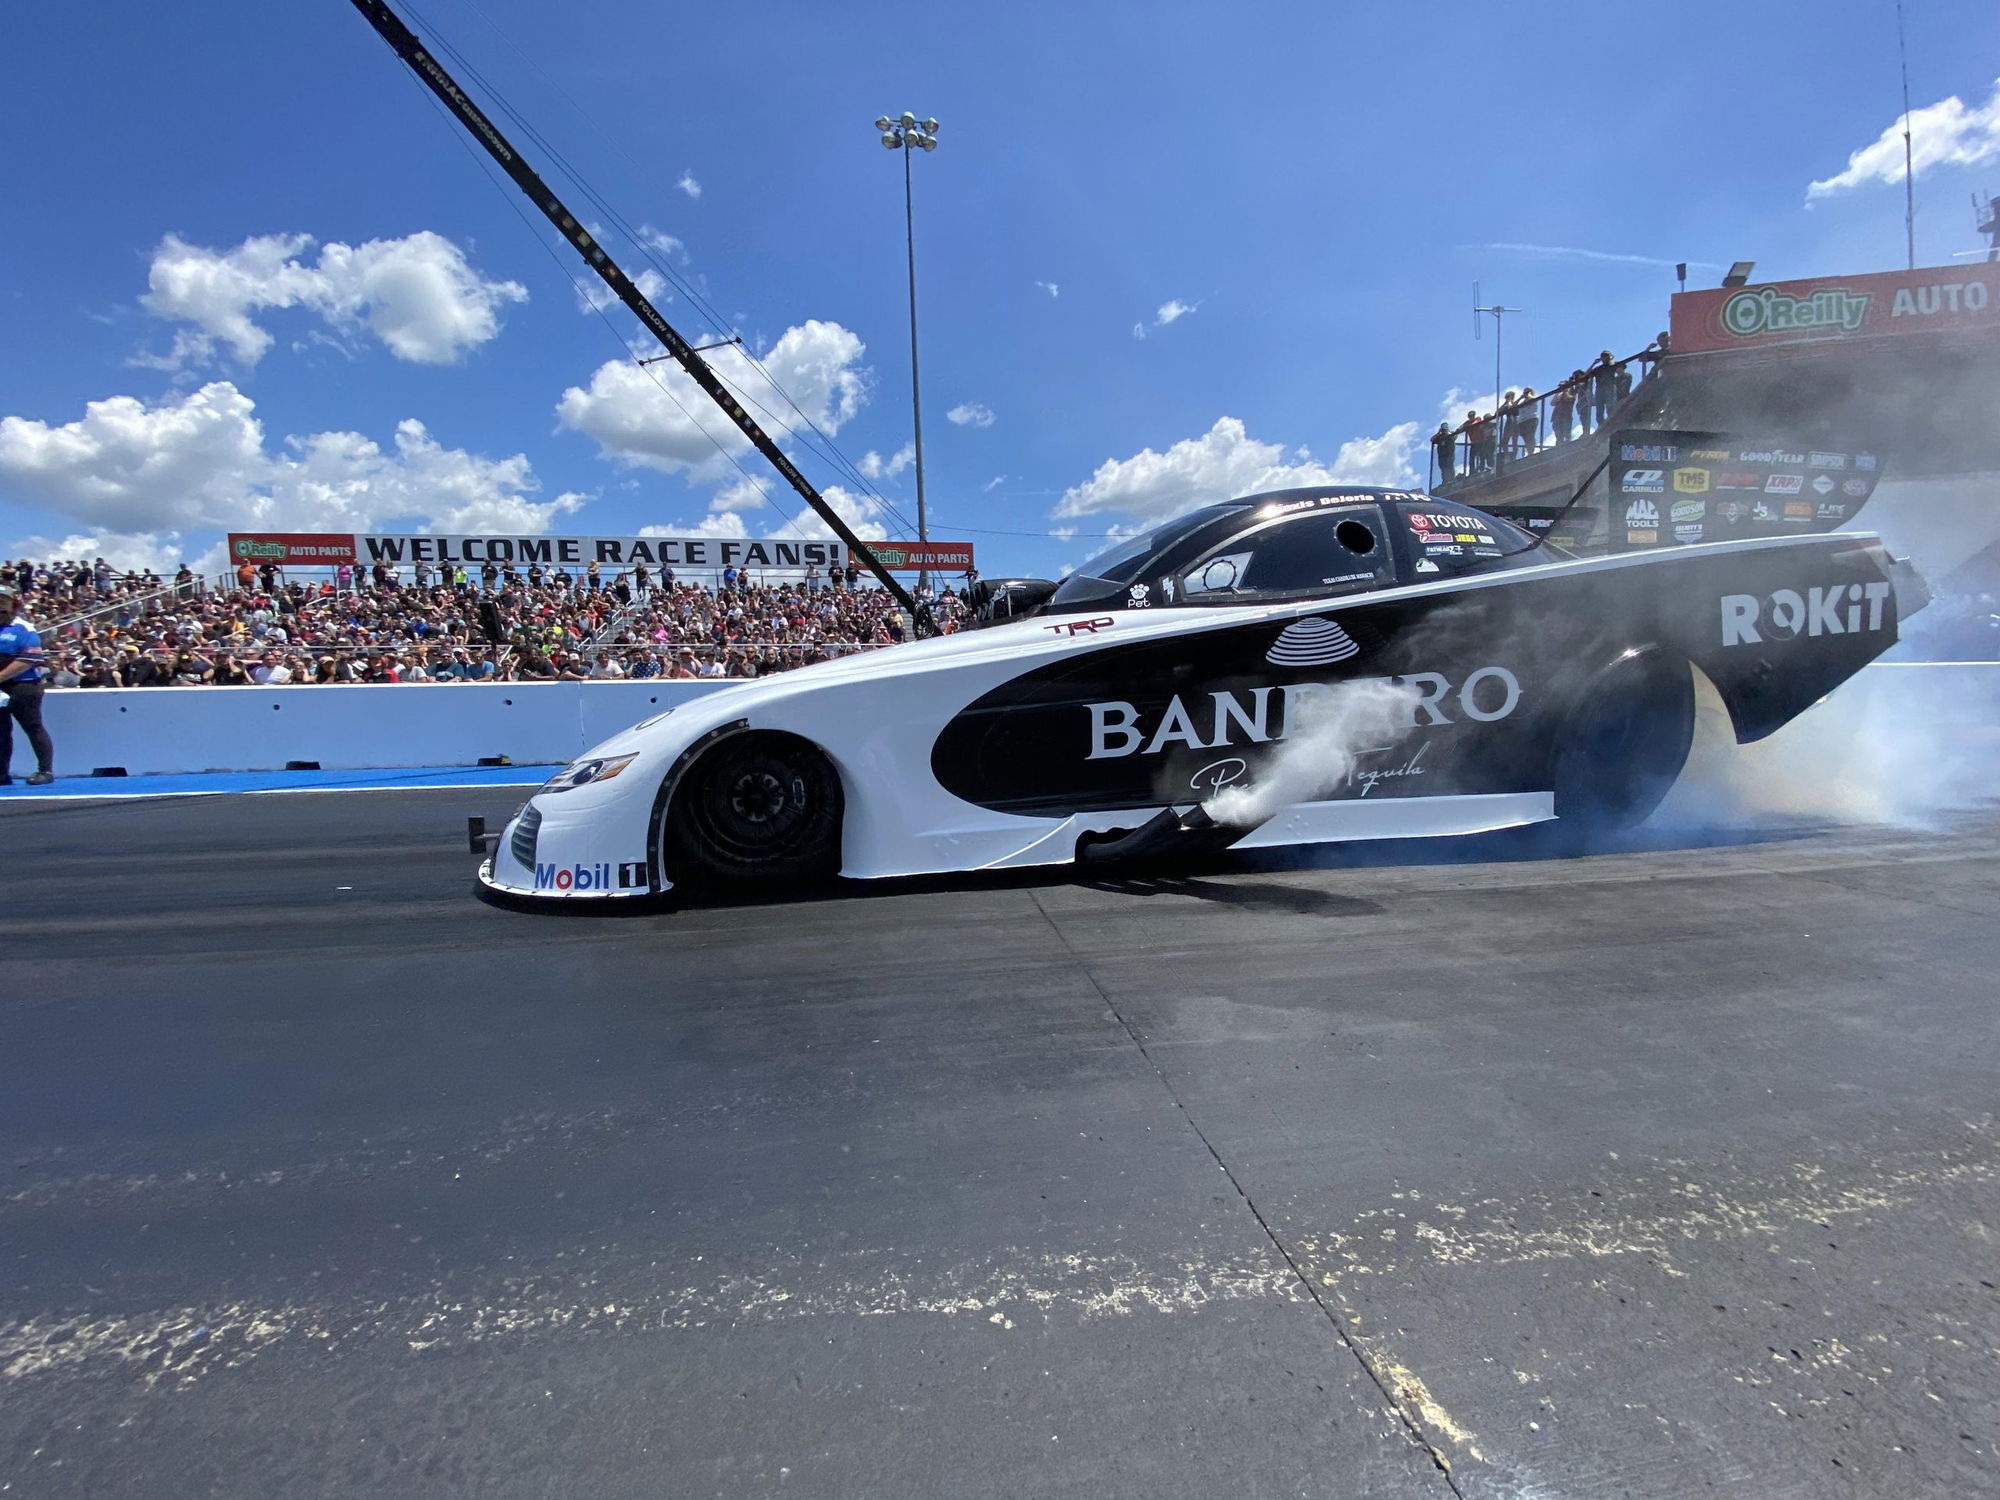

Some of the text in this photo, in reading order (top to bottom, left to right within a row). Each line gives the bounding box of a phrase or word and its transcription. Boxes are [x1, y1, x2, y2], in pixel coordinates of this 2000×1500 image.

[637, 300, 667, 332] FOLLOW
[1724, 288, 1869, 334] O'Reilly
[1891, 281, 1988, 317] AUTO
[1740, 450, 1804, 464] GOODYEAR
[1678, 473, 1704, 484] TMS
[1426, 514, 1487, 530] TOYOTA
[234, 540, 352, 559] O'Reilly AUTO PARTS
[365, 537, 840, 567] WELCOME RACE FANS!
[909, 552, 936, 563] AUTO
[937, 553, 970, 564] PARTS
[1128, 598, 1151, 608] Pet
[1044, 617, 1114, 636] TRD
[535, 863, 609, 889] Mobil
